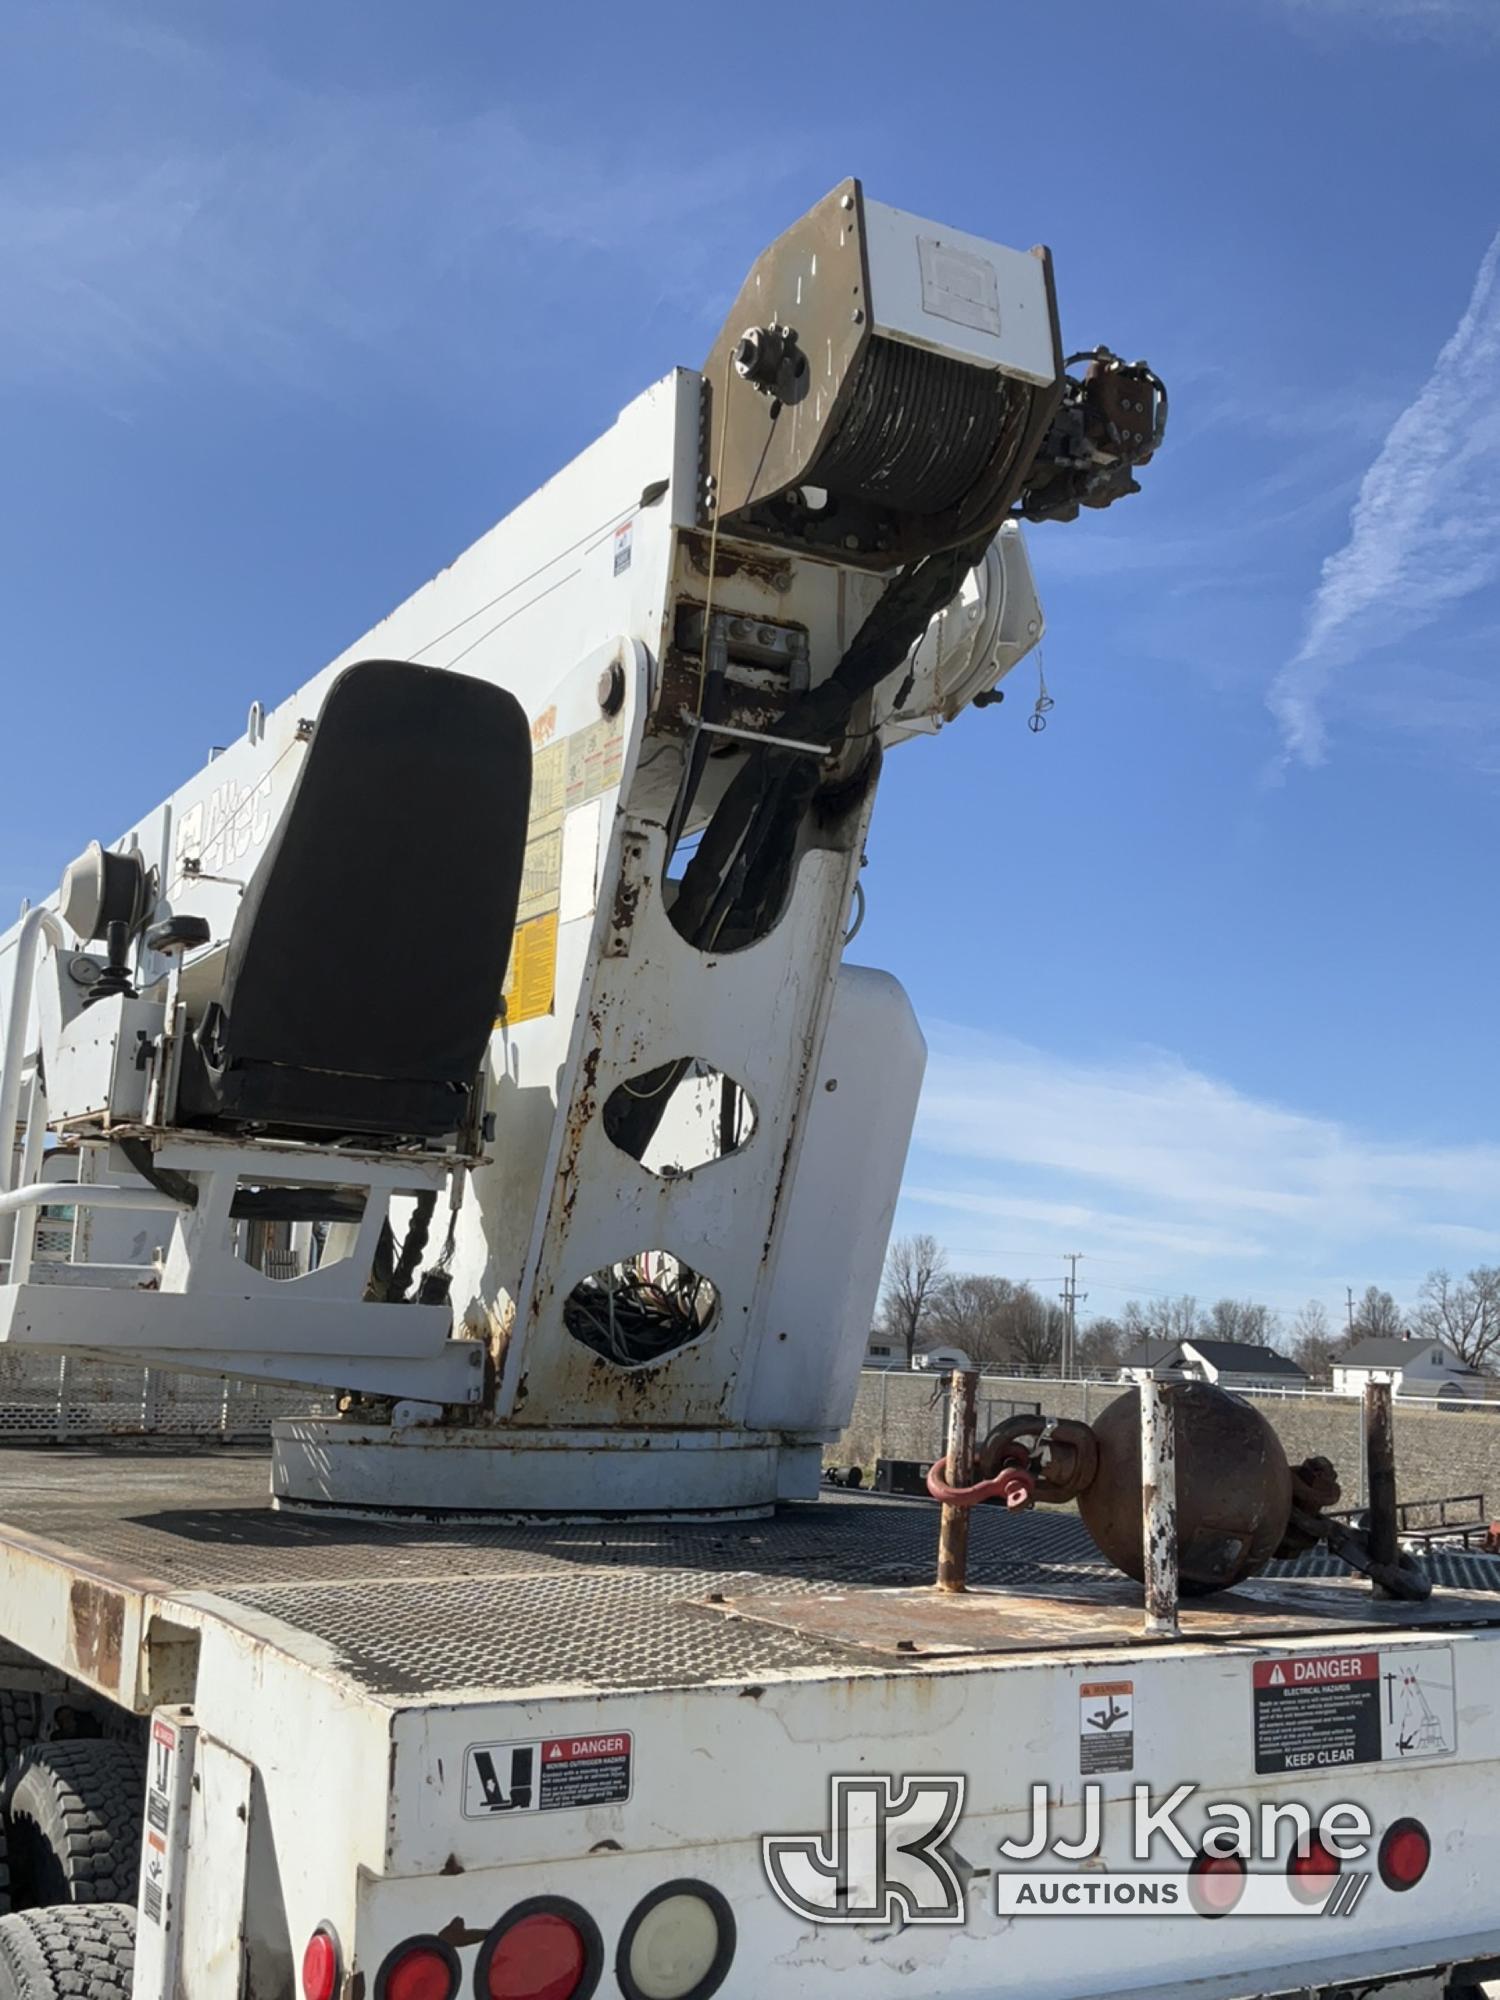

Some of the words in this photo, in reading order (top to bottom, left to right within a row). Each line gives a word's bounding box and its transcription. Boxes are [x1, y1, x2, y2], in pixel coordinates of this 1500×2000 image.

[1293, 1658, 1362, 1681] DANGER
[572, 1738, 623, 1755] DANGER
[1285, 1752, 1315, 1768] KEEP
[1317, 1748, 1355, 1764] CLEAR
